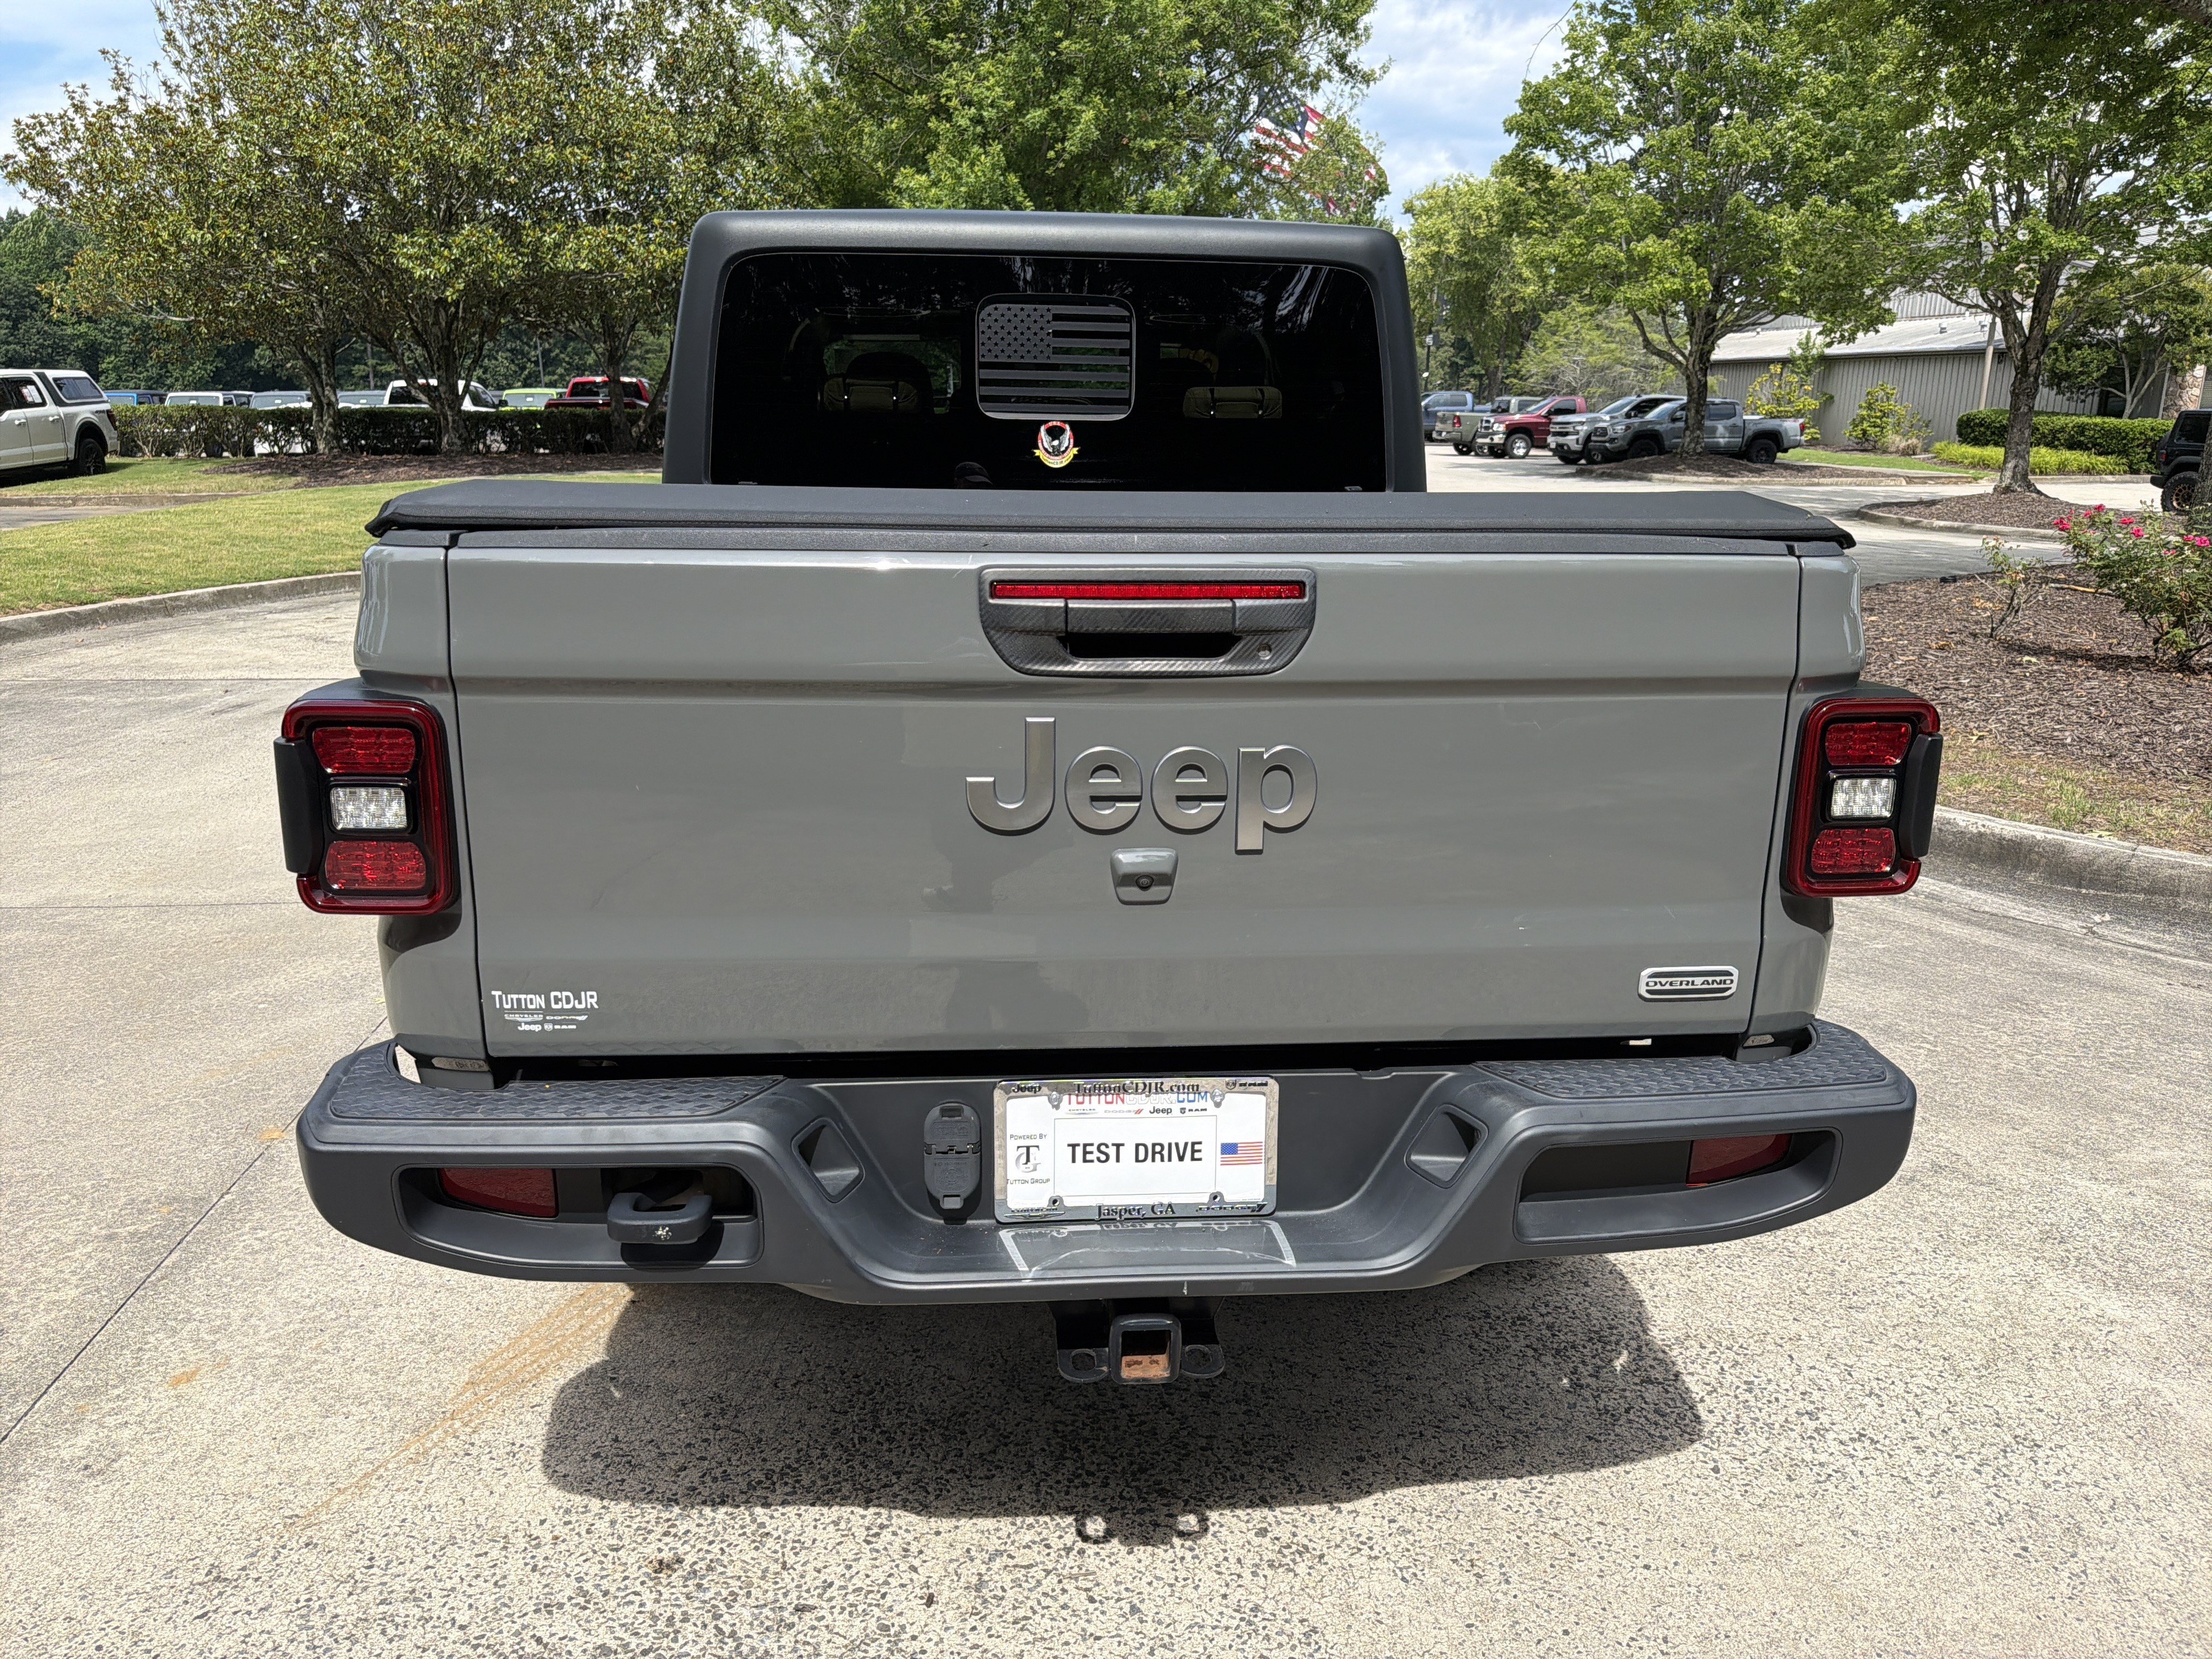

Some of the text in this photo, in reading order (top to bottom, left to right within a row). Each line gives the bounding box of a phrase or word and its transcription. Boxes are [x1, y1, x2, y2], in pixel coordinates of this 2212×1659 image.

[966, 717, 1317, 855] Jeep
[1645, 978, 1734, 988] OVERLAND
[550, 991, 599, 1009] CDJR
[517, 1022, 542, 1032] Jeep
[1011, 1082, 1042, 1094] Jeep
[1073, 1081, 1200, 1097] TuttonCDJR.com
[1149, 1106, 1172, 1115] Jeep
[1067, 1141, 1203, 1163] TEST DRIVE
[1095, 1201, 1177, 1219] Jasper, GA
